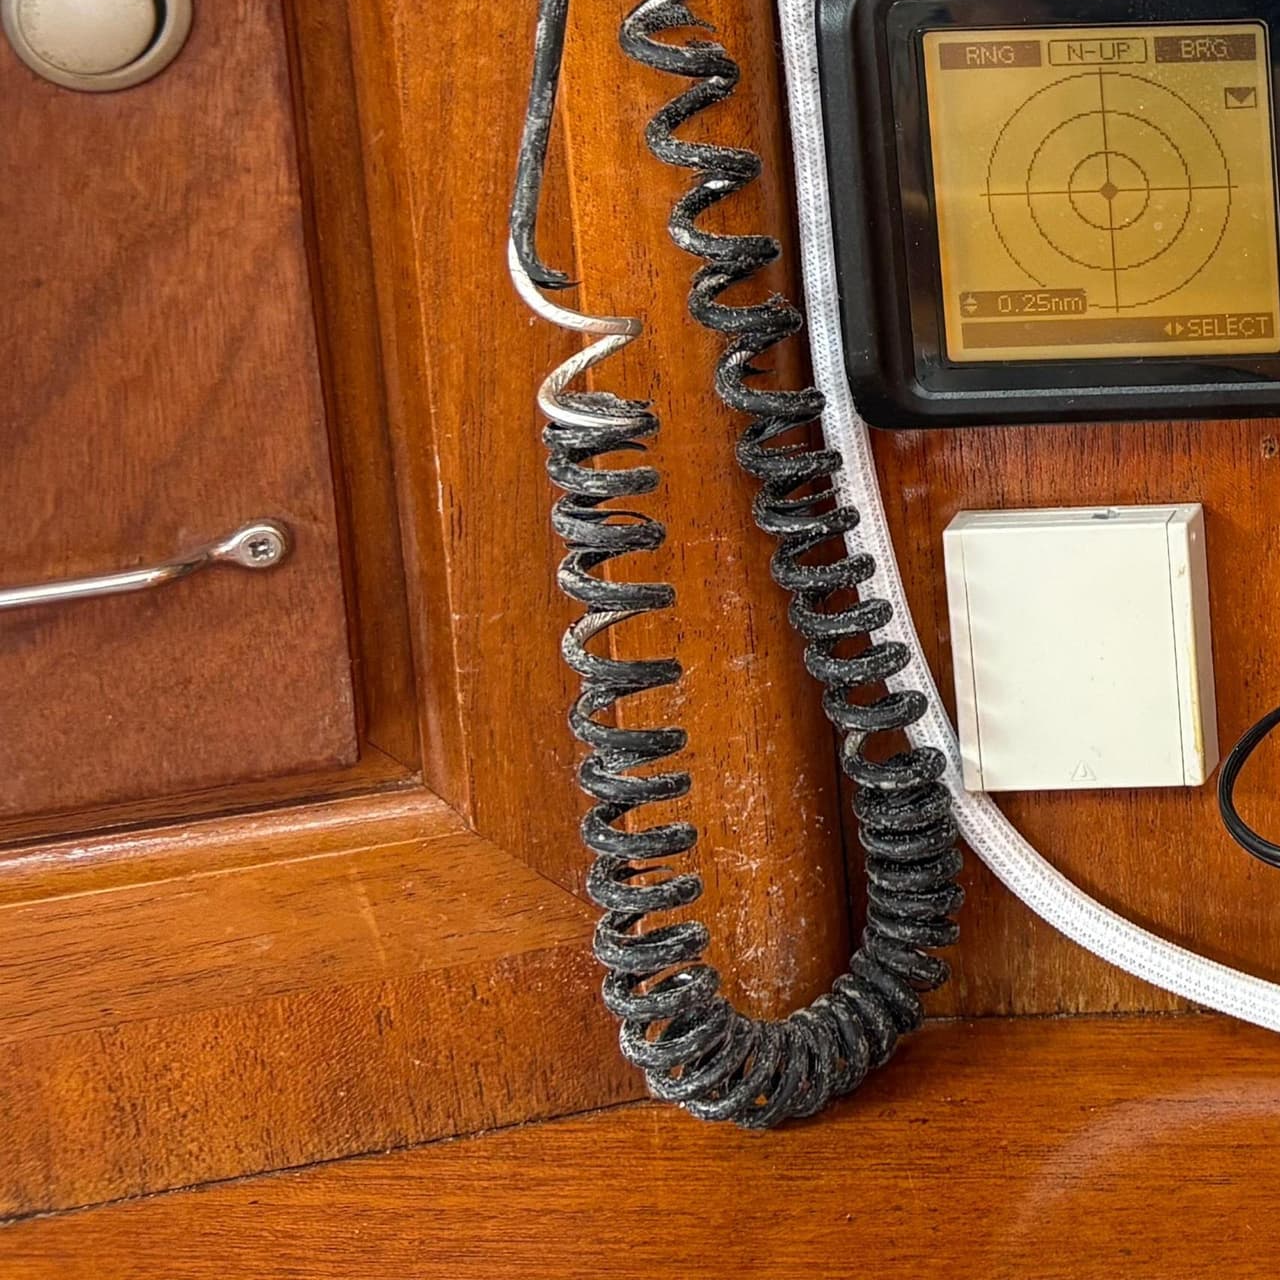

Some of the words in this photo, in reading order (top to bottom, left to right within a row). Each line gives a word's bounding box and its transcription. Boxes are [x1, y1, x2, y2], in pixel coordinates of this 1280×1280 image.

[966, 46, 1014, 64] RNG
[1067, 43, 1130, 61] N-UP
[1181, 39, 1228, 59] BRG
[998, 293, 1083, 313] 0.25nm
[1188, 318, 1268, 337] SELECT
